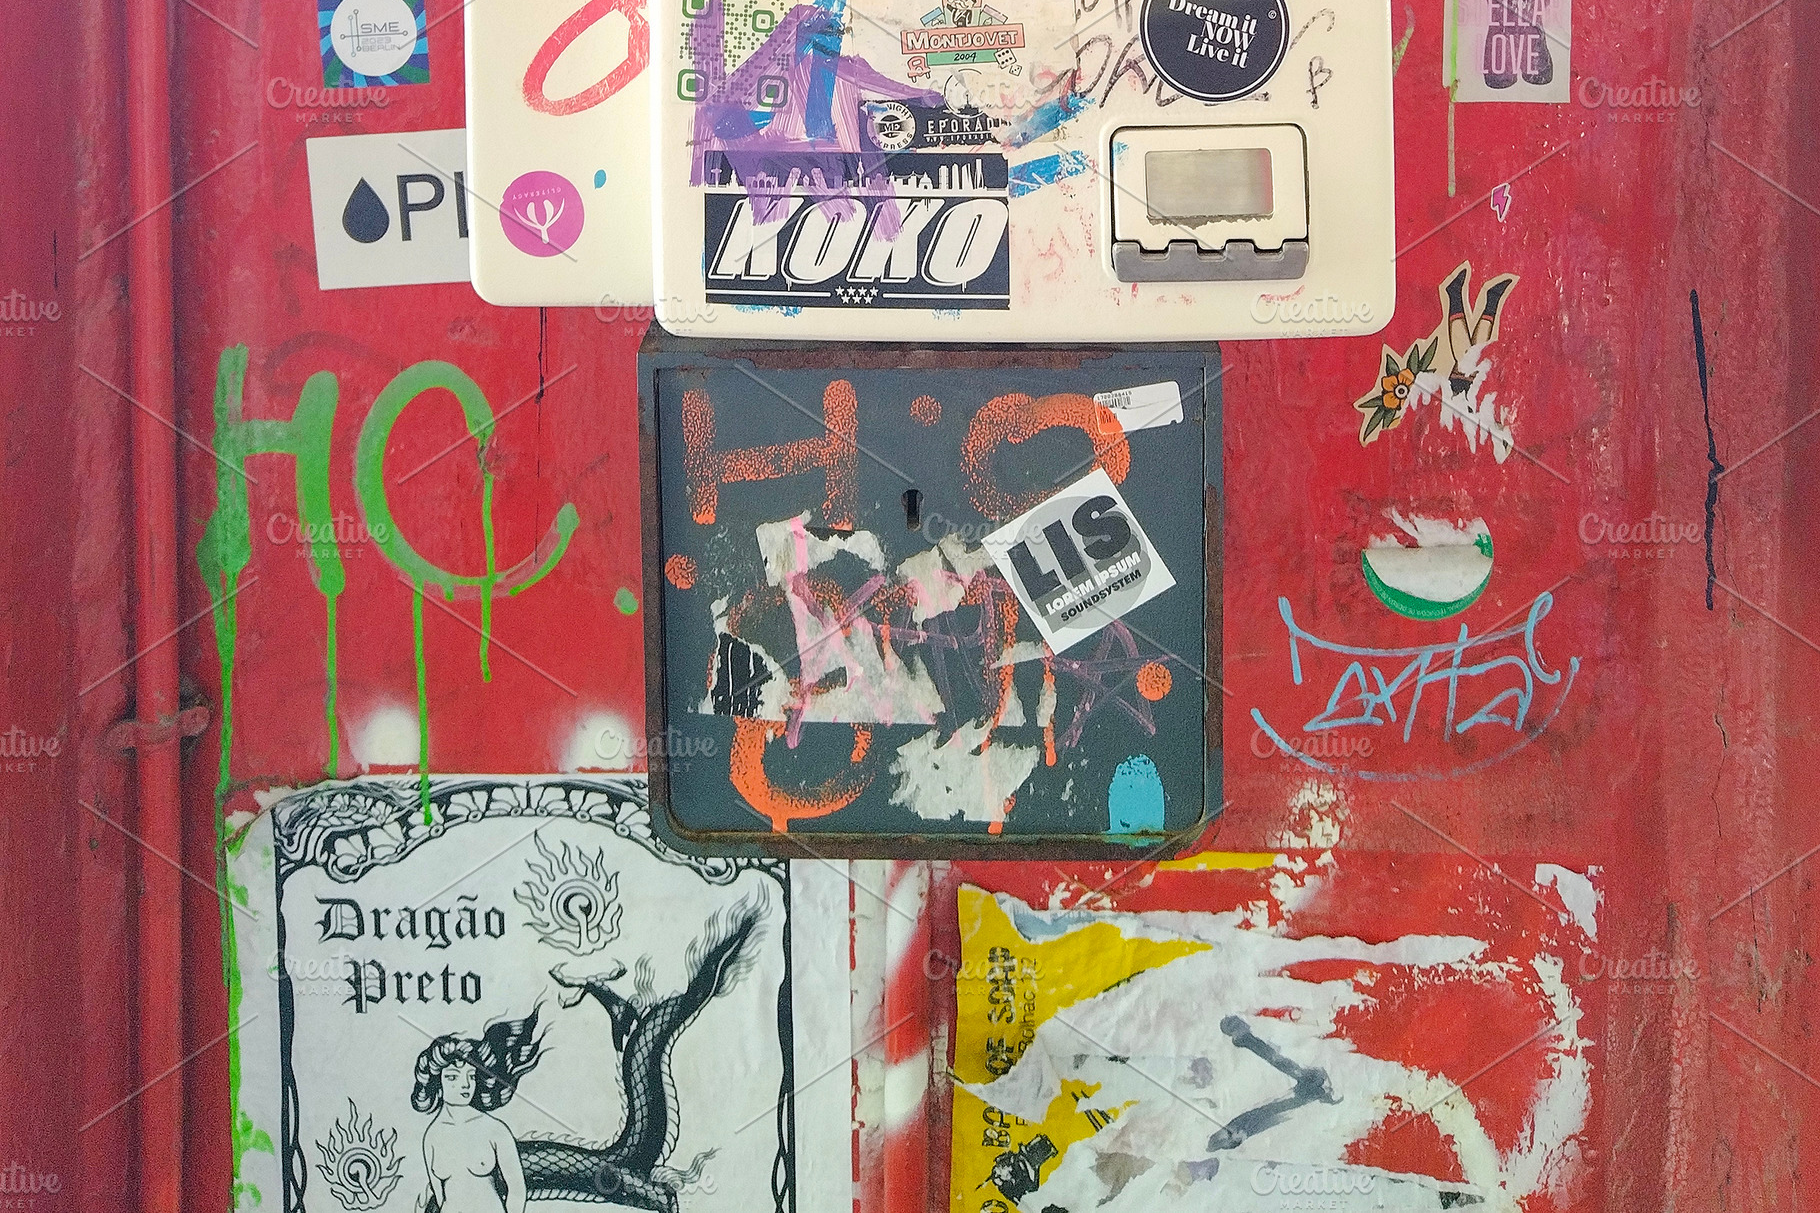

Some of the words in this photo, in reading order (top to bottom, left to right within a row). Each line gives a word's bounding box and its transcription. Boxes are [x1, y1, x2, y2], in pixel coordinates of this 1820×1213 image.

[360, 21, 400, 33] SME
[906, 30, 1018, 51] MONTJOVET
[1200, 20, 1255, 51] NOW
[1241, 14, 1258, 36] it
[1186, 33, 1230, 62] Live
[1231, 47, 1249, 69] it
[1476, 34, 1541, 75] LOVE
[708, 197, 1010, 286] KOKO
[1006, 495, 1132, 602] LIS
[1045, 576, 1095, 615] LOREM
[1092, 552, 1142, 588] IPSUM
[1060, 568, 1142, 623] SOUNDSYSTEM
[313, 893, 506, 951] Dragão
[341, 958, 482, 1015] Preto
[986, 946, 1017, 1025] SOAP
[981, 1105, 1011, 1148] BA
